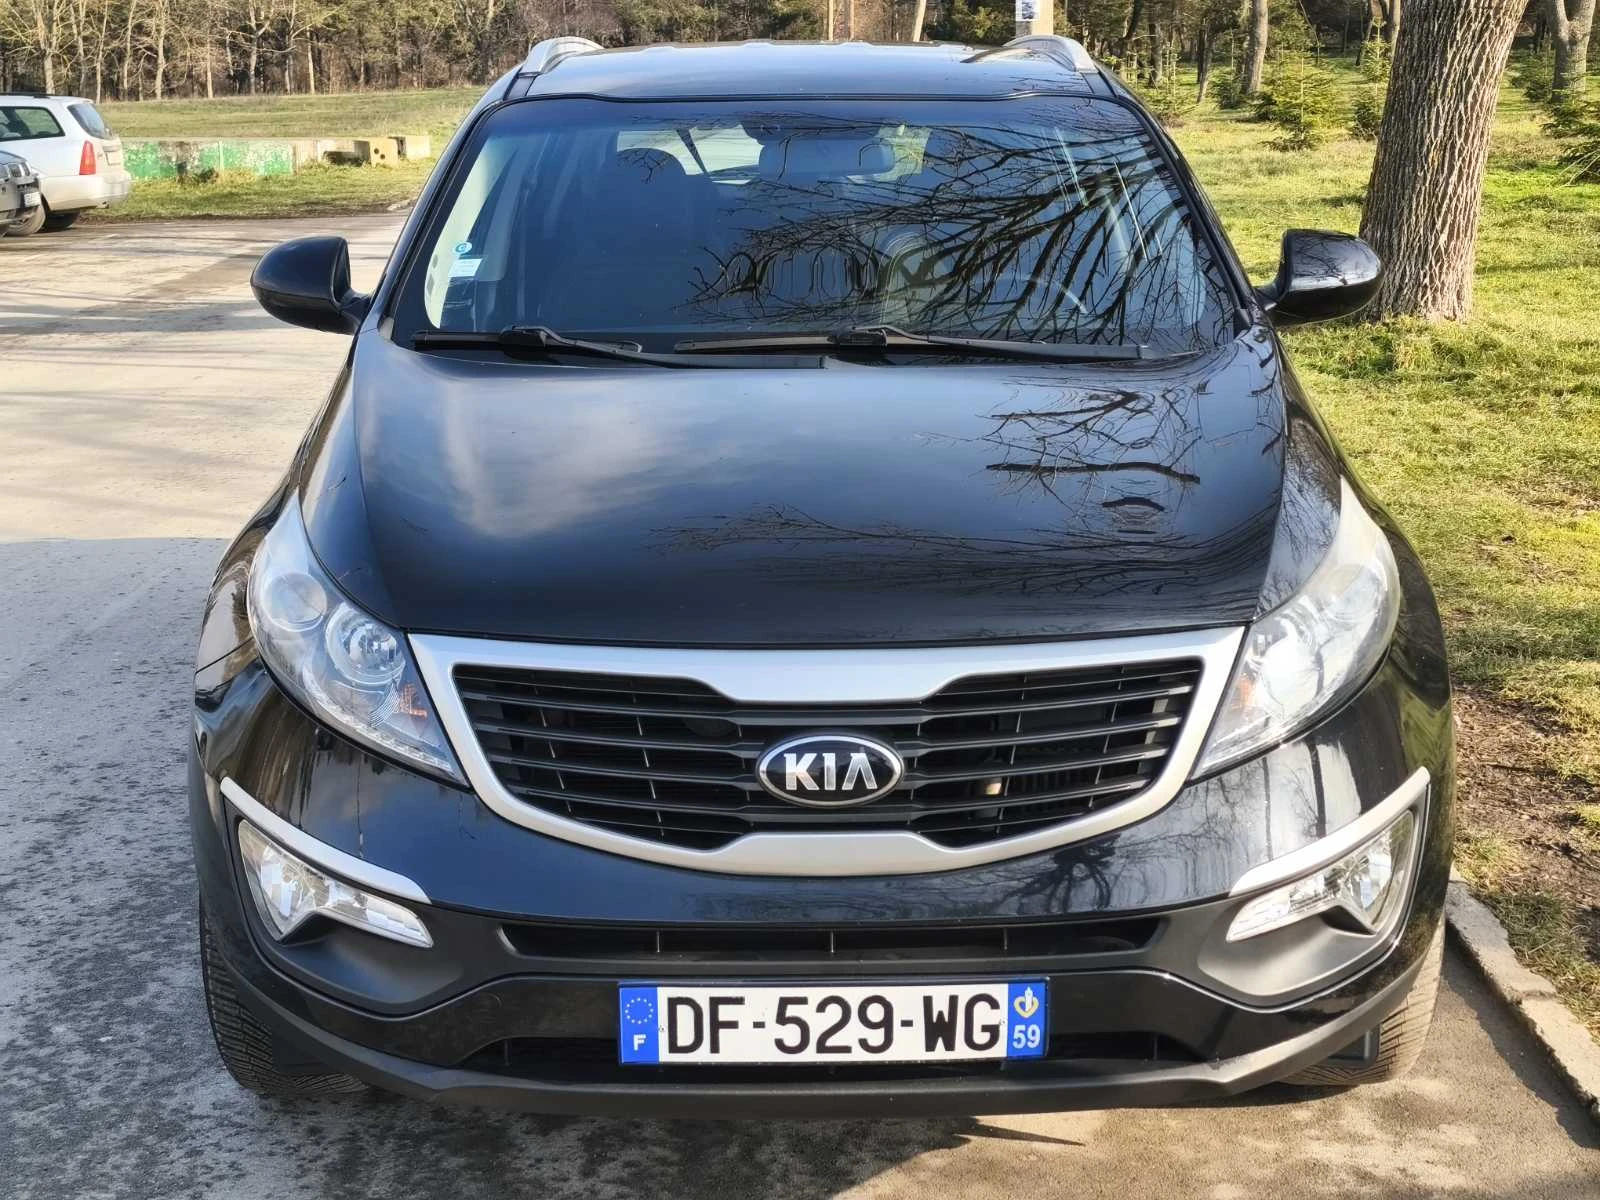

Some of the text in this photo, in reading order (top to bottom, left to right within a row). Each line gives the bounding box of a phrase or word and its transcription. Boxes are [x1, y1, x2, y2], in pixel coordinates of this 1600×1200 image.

[784, 752, 878, 790] KIA
[667, 993, 1001, 1054] DF-529-WG
[1012, 1024, 1041, 1050] 59
[633, 1034, 646, 1051] F
